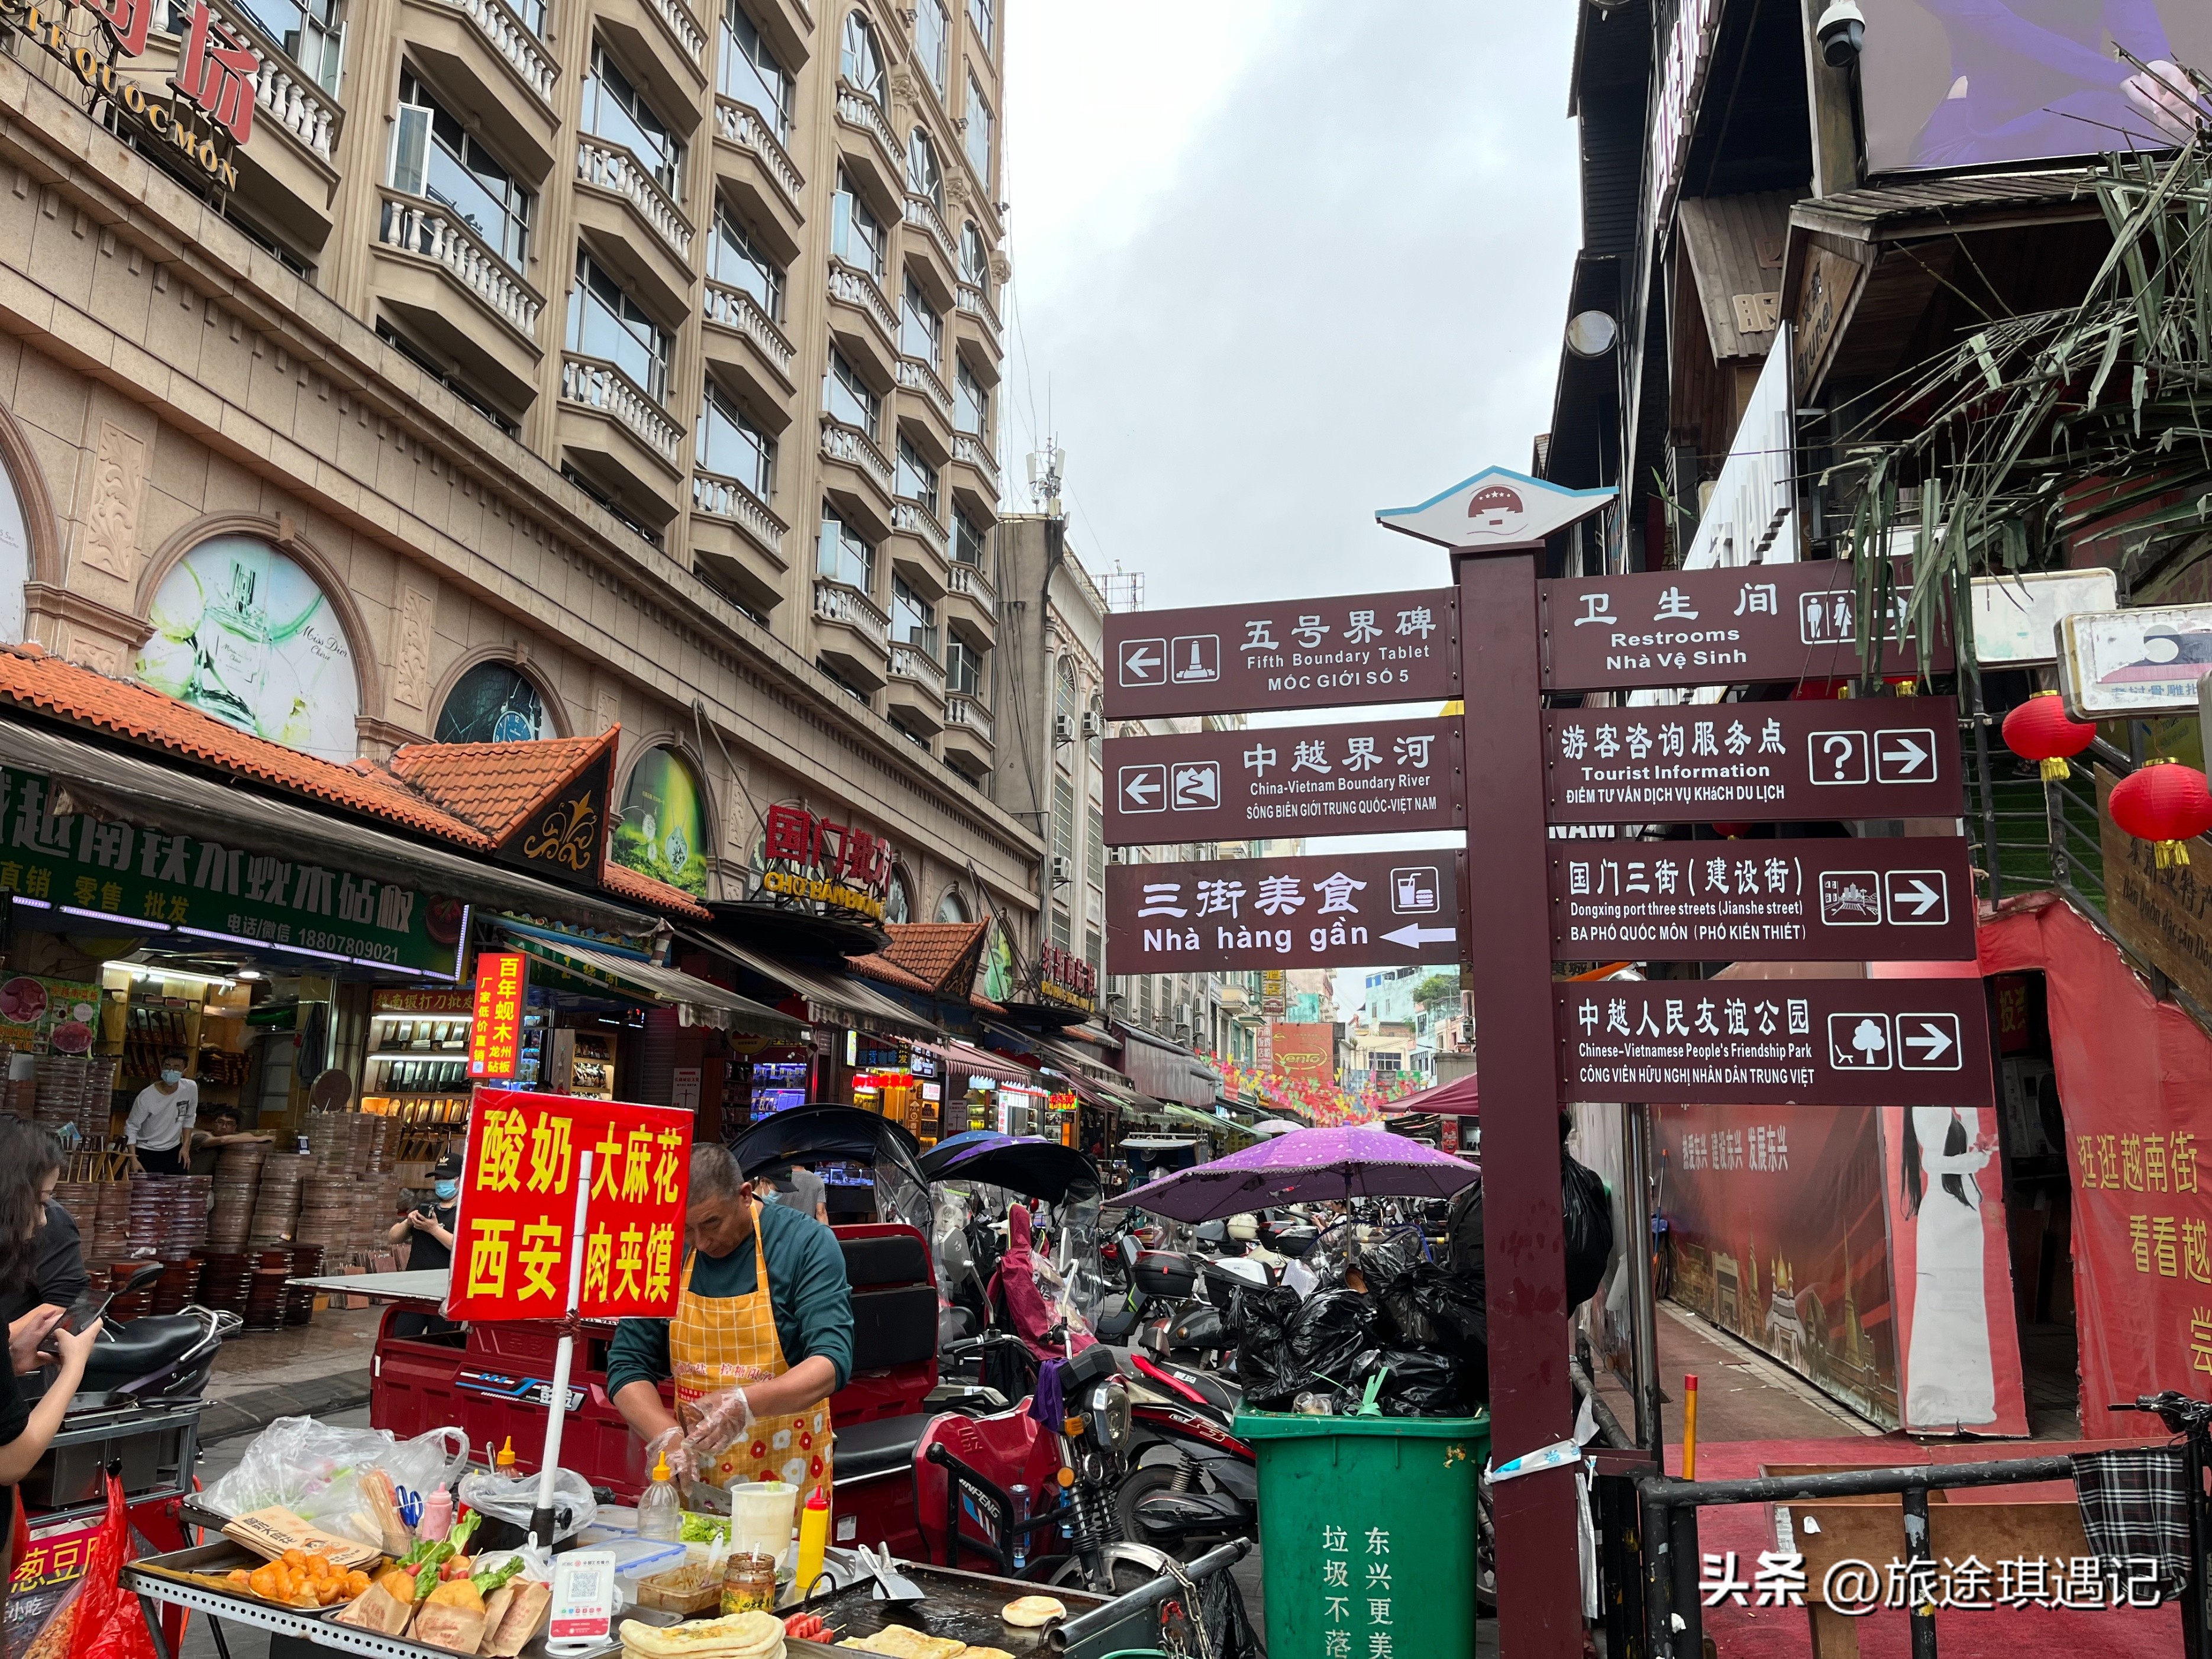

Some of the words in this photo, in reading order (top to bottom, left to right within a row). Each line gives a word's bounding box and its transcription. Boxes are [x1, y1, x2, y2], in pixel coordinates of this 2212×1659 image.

[1574, 583, 1777, 626] 卫生间
[1240, 606, 1436, 651] 五号界碑
[1612, 630, 1739, 647] Restrooms
[325, 635, 348, 658] Dior
[1248, 655, 1283, 669] Fifth
[1293, 650, 1370, 666] Boundary
[1378, 645, 1429, 660] Tablet
[1607, 654, 1651, 669] Nhà
[1694, 650, 1746, 665] Sinh
[1400, 670, 1408, 682] 5
[1562, 718, 1785, 760] 游客咨询服务点
[1244, 735, 1435, 777] 中越界河
[1581, 766, 1649, 780] Tourist
[1655, 763, 1769, 779] Information
[1251, 780, 1335, 795] China-Vietnam
[1338, 776, 1395, 790] Boundary
[1399, 774, 1430, 787] River
[1598, 789, 1614, 802] TƯ
[1737, 786, 1753, 799] DU
[1247, 803, 1273, 819] SÔNG
[1276, 801, 1297, 818] BIÊN
[1323, 801, 1356, 815] TRUNG
[1415, 796, 1436, 810] NAM
[73, 876, 123, 912] 零售
[144, 890, 190, 925] 批发
[1138, 872, 1367, 921] 三街美食
[1571, 902, 1620, 918] Dongxing
[1624, 903, 1645, 918] port
[1648, 902, 1675, 915] three
[1679, 902, 1716, 915] streets
[1719, 900, 1764, 916] (Jianshe
[1767, 900, 1802, 915] street)
[298, 928, 399, 963] 18807809021
[1144, 928, 1200, 951] Nhà
[1218, 925, 1291, 953] hàng
[1571, 927, 1588, 940] BA
[1659, 922, 1687, 940] MÔN
[1579, 998, 1809, 1038] 中越人民友谊公园
[1580, 1043, 1683, 1057] Chinese-Vietnamese
[1687, 1043, 1729, 1060] People's
[1732, 1043, 1785, 1060] Friendship
[1788, 1043, 1811, 1057] Park
[1580, 1064, 1610, 1082] CÔNG
[1612, 1064, 1636, 1082] VIÊN
[1693, 1065, 1722, 1083] NHÂN
[1725, 1065, 1747, 1083] DÂN
[1750, 1069, 1787, 1083] TRUNG
[477, 1107, 573, 1195] 酸奶
[590, 1121, 683, 1205] 大麻花
[1711, 1129, 1743, 1171] 建设东兴
[1748, 1124, 1788, 1172] 发展东兴
[2077, 1131, 2198, 1194] 逛逛越南街
[466, 1215, 562, 1302] 西安
[583, 1221, 675, 1303] 肉夹馍
[1322, 1524, 1352, 1659] 垃圾不落
[1364, 1526, 1394, 1659] 东兴更美
